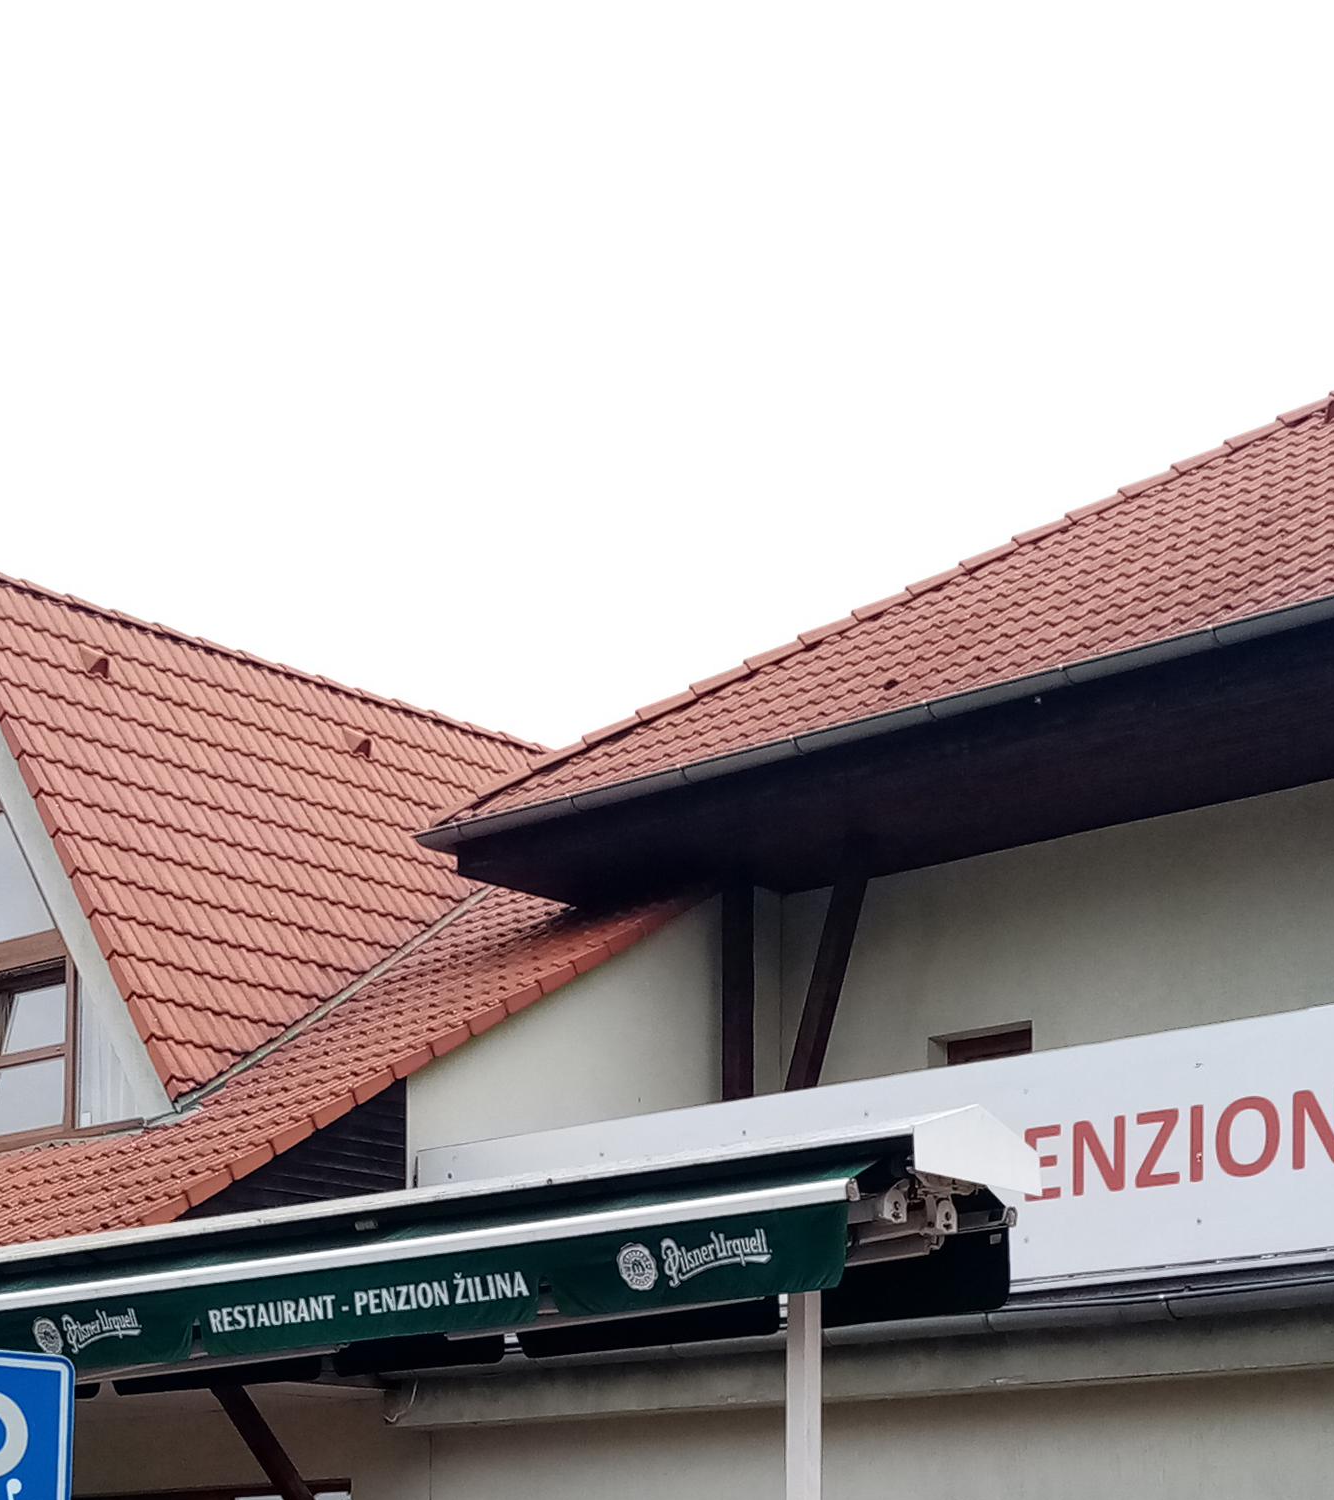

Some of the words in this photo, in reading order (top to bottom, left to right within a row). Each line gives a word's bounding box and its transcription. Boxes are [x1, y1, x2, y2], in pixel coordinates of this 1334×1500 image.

[660, 1238, 715, 1288] Pilsner
[710, 1228, 768, 1267] Urquell
[208, 1294, 335, 1333] RESTAURANT
[354, 1280, 451, 1317] PENZION
[453, 1271, 530, 1305] ŽILINA
